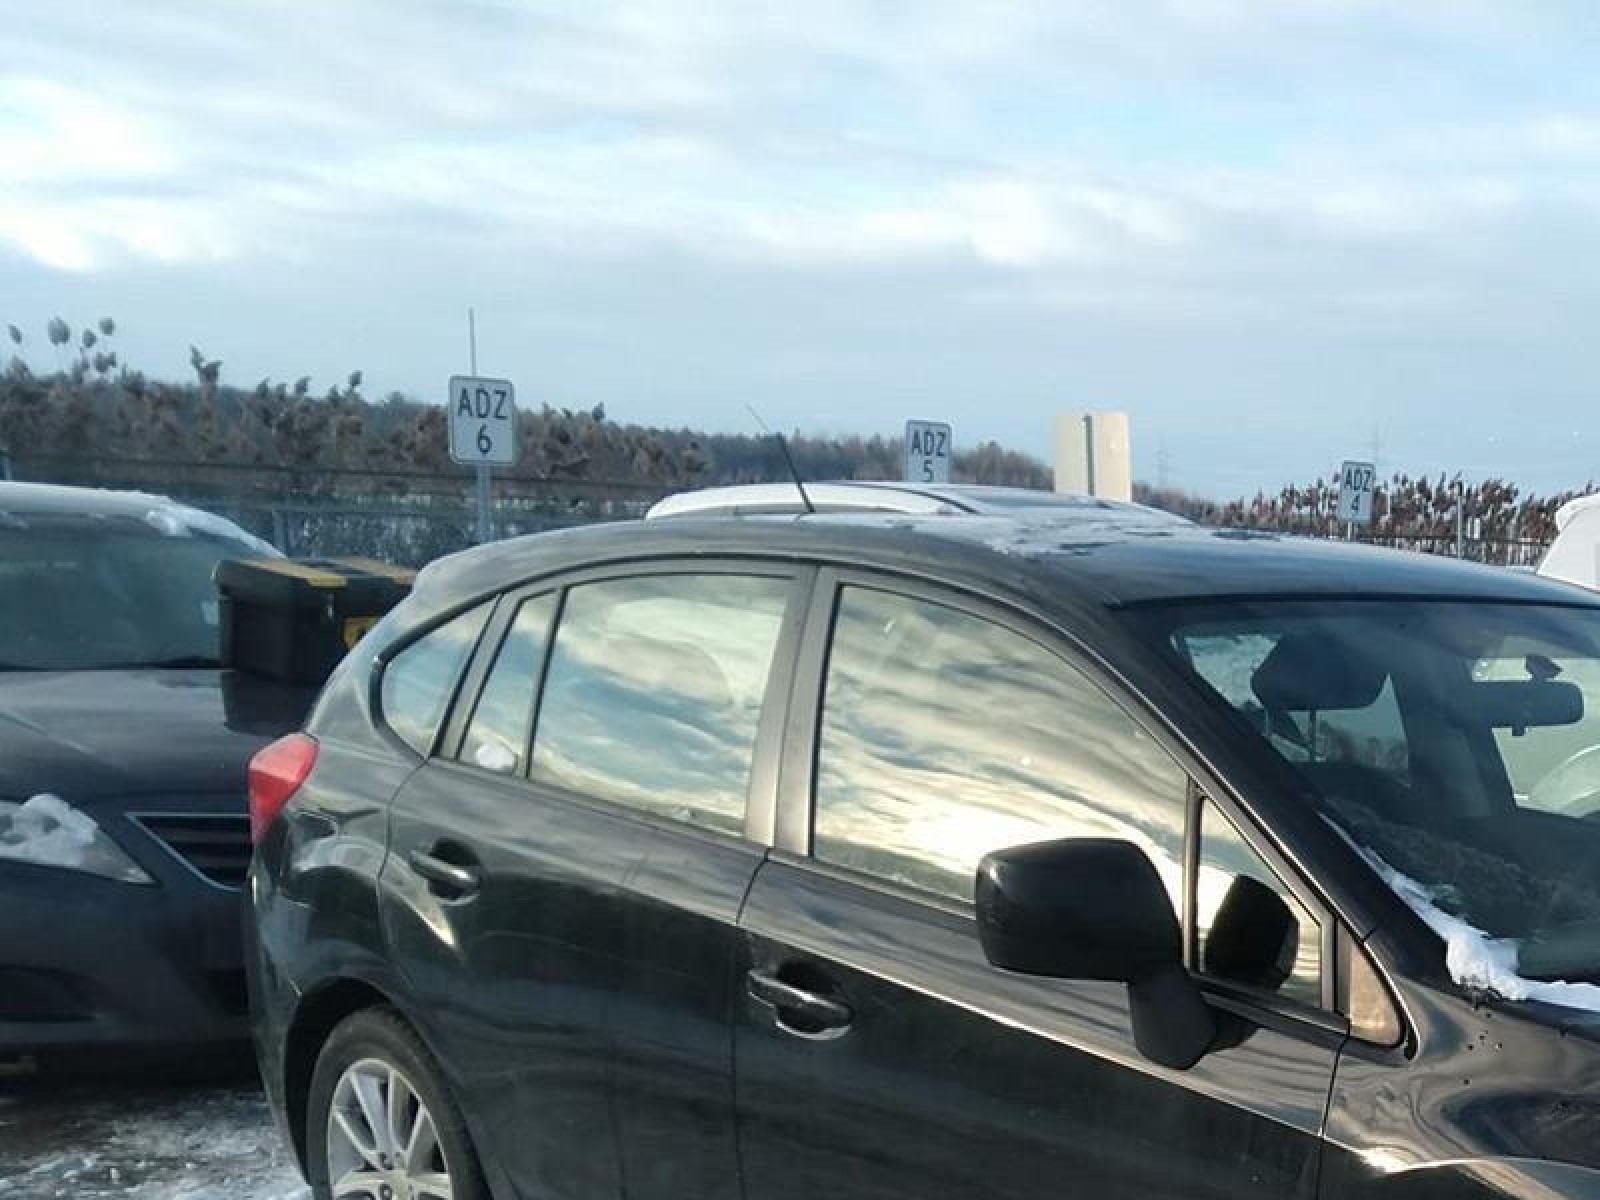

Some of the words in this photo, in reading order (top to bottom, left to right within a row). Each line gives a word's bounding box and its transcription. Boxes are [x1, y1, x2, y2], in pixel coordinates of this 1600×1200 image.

[457, 386, 508, 420] ADZ
[477, 423, 492, 456] 6
[911, 429, 947, 458] ADZ
[923, 459, 934, 483] 5
[1344, 468, 1371, 492] ADZ
[1351, 494, 1360, 514] 4
